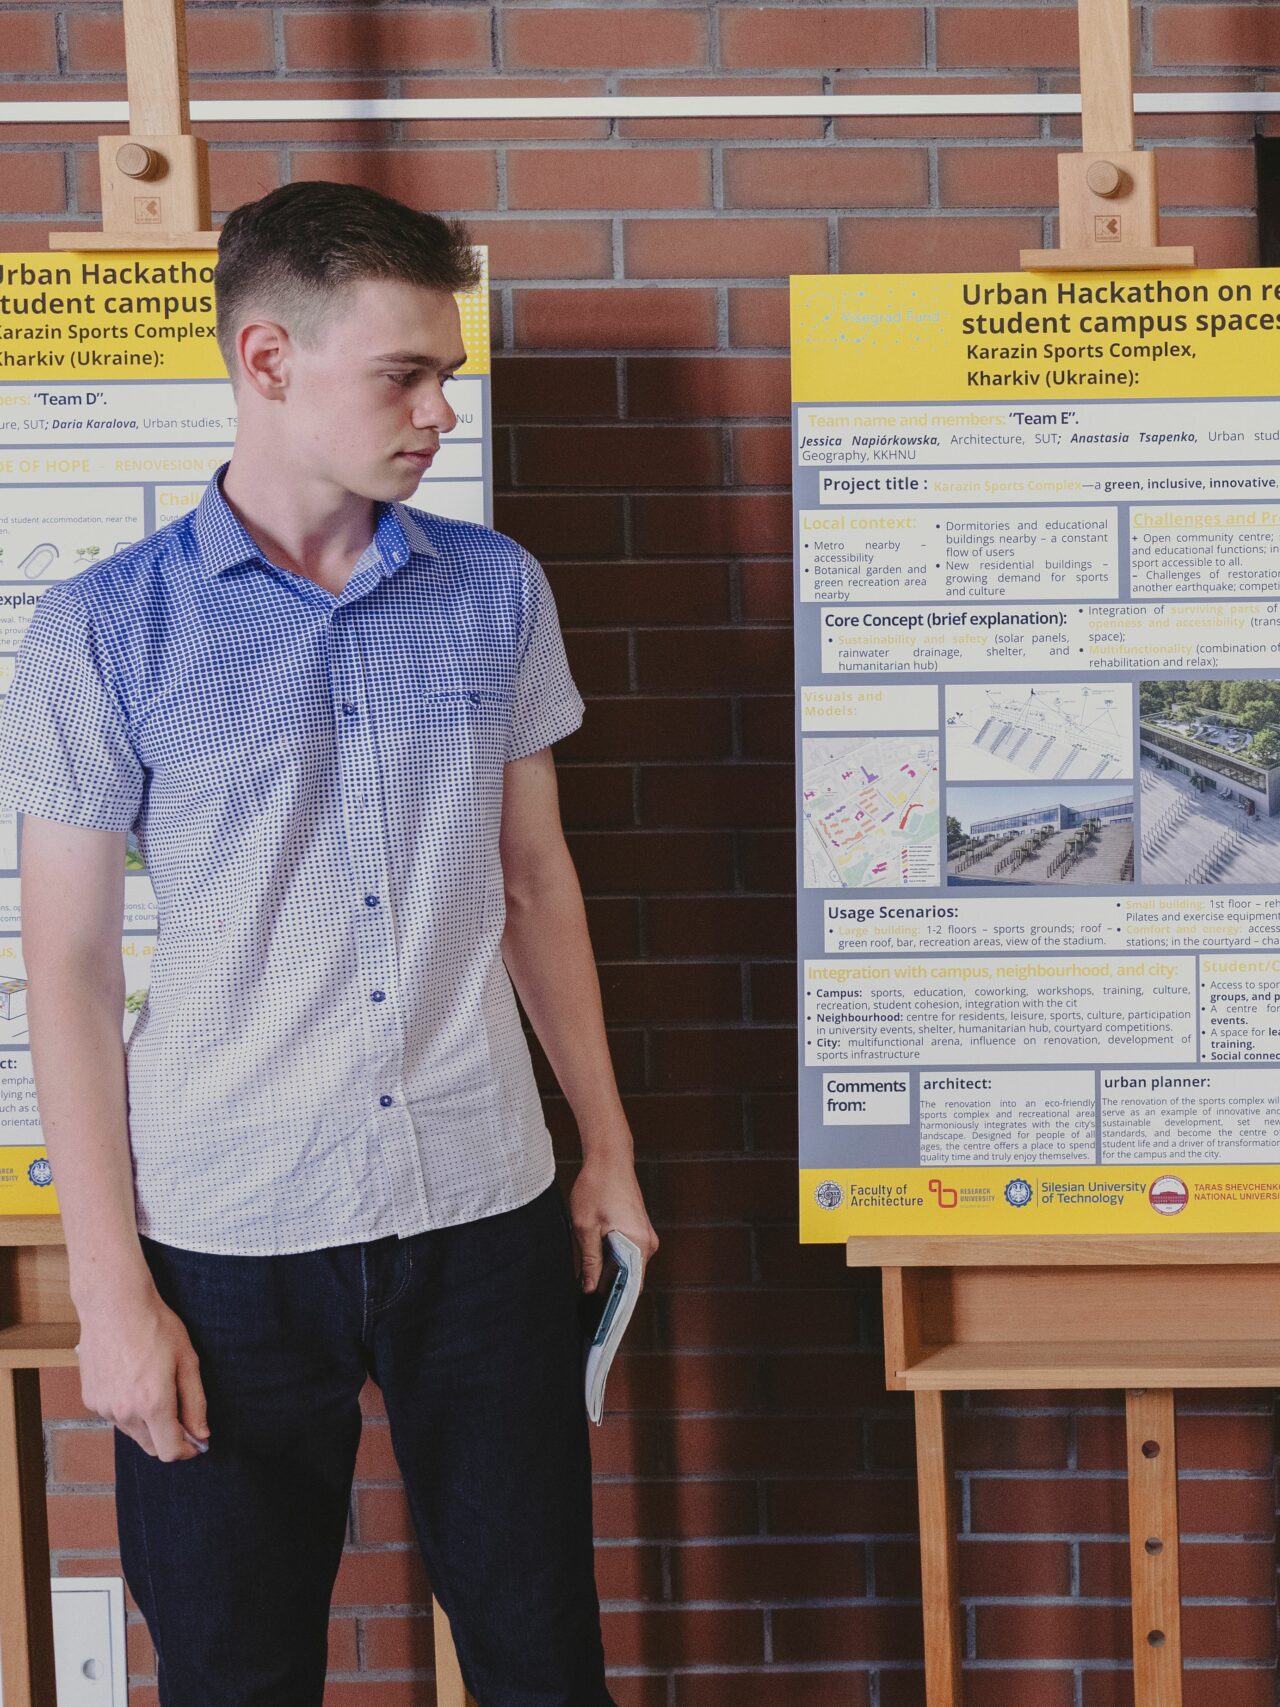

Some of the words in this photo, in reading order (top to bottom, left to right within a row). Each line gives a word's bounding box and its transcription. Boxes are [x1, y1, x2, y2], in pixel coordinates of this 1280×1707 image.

[82, 261, 215, 285] Hackatho
[963, 282, 1046, 305] Urban
[1057, 279, 1208, 303] Hackathon
[1218, 284, 1251, 301] on
[0, 292, 95, 314] tudent
[104, 295, 212, 319] campus
[962, 311, 1070, 334] student
[1079, 314, 1186, 337] campus
[68, 323, 128, 343] Sports
[70, 349, 163, 368] (Ukraine):
[967, 343, 1037, 359] Karazin
[1043, 343, 1103, 362] Sports
[1109, 341, 1195, 362] Complex,
[967, 370, 1039, 386] Kharkiv
[1045, 368, 1138, 388] (Ukraine):
[33, 392, 81, 405] “Team
[86, 392, 106, 405] D”.
[23, 419, 48, 430] SUT;
[52, 419, 82, 429] Daria
[86, 418, 138, 429] Karalova,
[143, 418, 177, 428] Urban
[181, 417, 223, 428] studies,
[808, 414, 851, 428] Team
[853, 416, 896, 427] name
[899, 413, 928, 426] and
[931, 412, 1005, 426] members:
[1008, 411, 1056, 425] “Team
[1061, 411, 1078, 424] E”.
[799, 435, 842, 448] Jessica
[851, 434, 939, 448] Napiórkowska,
[950, 433, 1024, 446] Architecture,
[1034, 433, 1061, 445] SUT;
[1070, 432, 1129, 443] Anastasia
[1139, 431, 1197, 445] Tsapenko,
[1208, 430, 1244, 441] Urban
[802, 449, 869, 464] Geography,
[873, 449, 915, 460] KKHNU
[824, 477, 880, 494] Project
[885, 476, 918, 490] title
[933, 481, 983, 492] Karazin
[984, 480, 1024, 493] Sports
[1104, 481, 1143, 492] green,
[1147, 478, 1205, 490] inclusive,
[1209, 476, 1278, 488] innovative,
[803, 516, 847, 530] Local
[850, 515, 916, 529] context:
[946, 520, 1009, 530] Dormitories
[1017, 520, 1037, 530] and
[1045, 519, 1107, 529] educational
[1133, 511, 1221, 528] Challenges
[1225, 512, 1256, 526] and
[825, 614, 859, 627] Core
[862, 613, 923, 630] Concept
[927, 612, 967, 628] (brief
[970, 610, 1066, 628] explanation):
[805, 691, 852, 702] Visuals
[858, 691, 881, 702] and
[805, 706, 857, 716] Models:
[828, 906, 874, 923] Usage
[879, 905, 958, 918] Scenarios:
[809, 966, 889, 983] Integration
[893, 966, 926, 979] with
[930, 968, 992, 982] campus,
[996, 965, 1112, 981] neighbourhood,
[1117, 964, 1144, 977] and
[1148, 963, 1178, 980] city:
[827, 1079, 906, 1093] Comments
[923, 1077, 991, 1089] architect:
[1104, 1076, 1146, 1088] urban
[1151, 1075, 1210, 1091] planner:
[827, 1097, 865, 1112] from:
[851, 1184, 892, 1196] Faculty
[895, 1184, 907, 1194] of
[1042, 1181, 1085, 1193] Silesian
[1088, 1181, 1146, 1195] University
[1194, 1192, 1237, 1200] NATIONAL
[850, 1195, 924, 1207] Architecture
[1042, 1193, 1052, 1204] of
[1054, 1193, 1124, 1206] Technology
